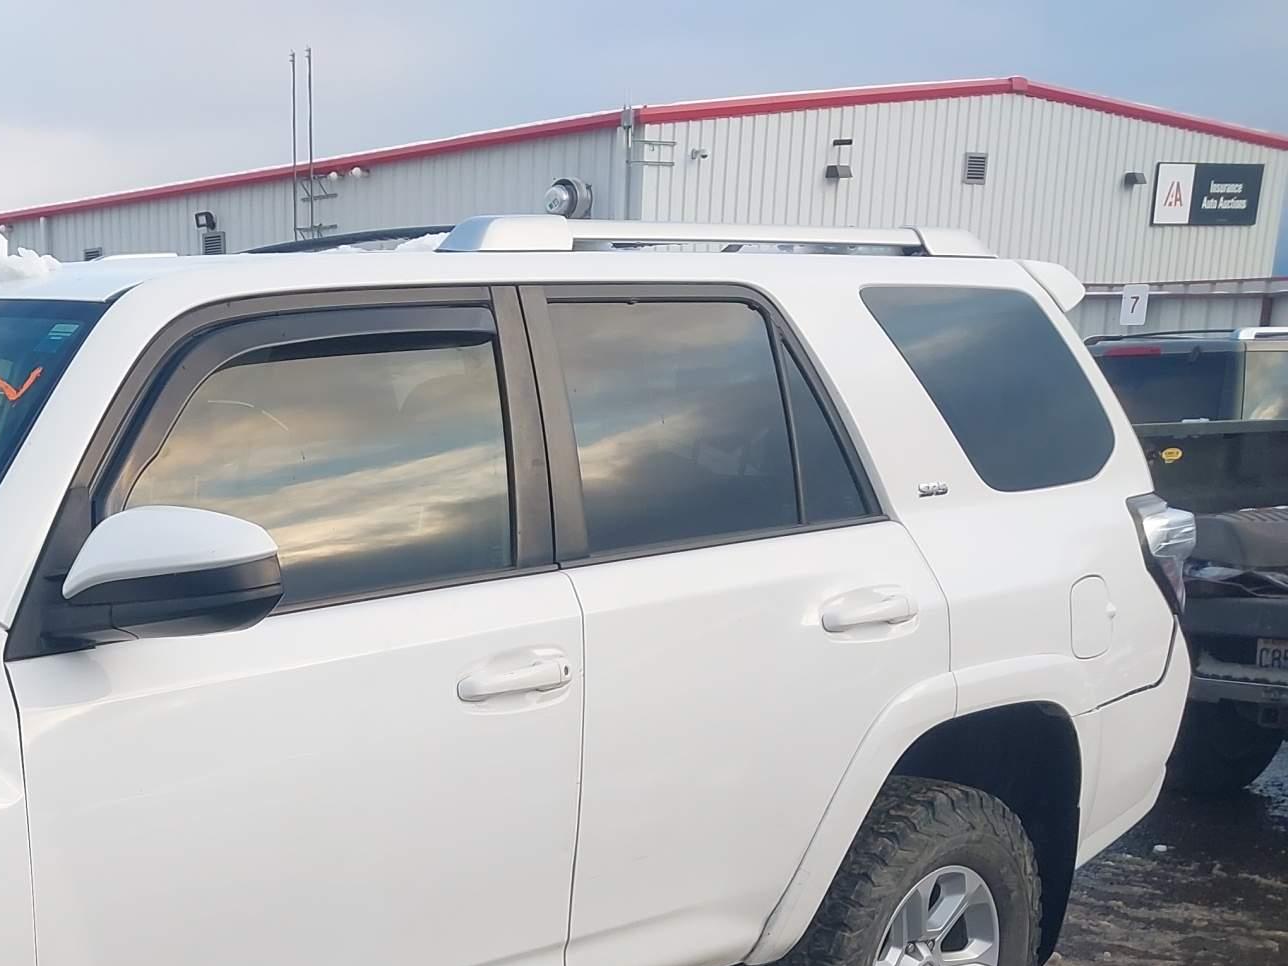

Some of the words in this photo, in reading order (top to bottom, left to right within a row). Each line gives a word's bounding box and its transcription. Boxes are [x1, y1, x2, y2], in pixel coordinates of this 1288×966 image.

[1209, 180, 1243, 194] Insurance
[1201, 196, 1217, 210] Auto
[1217, 196, 1247, 210] Auctions
[1130, 296, 1140, 314] 7
